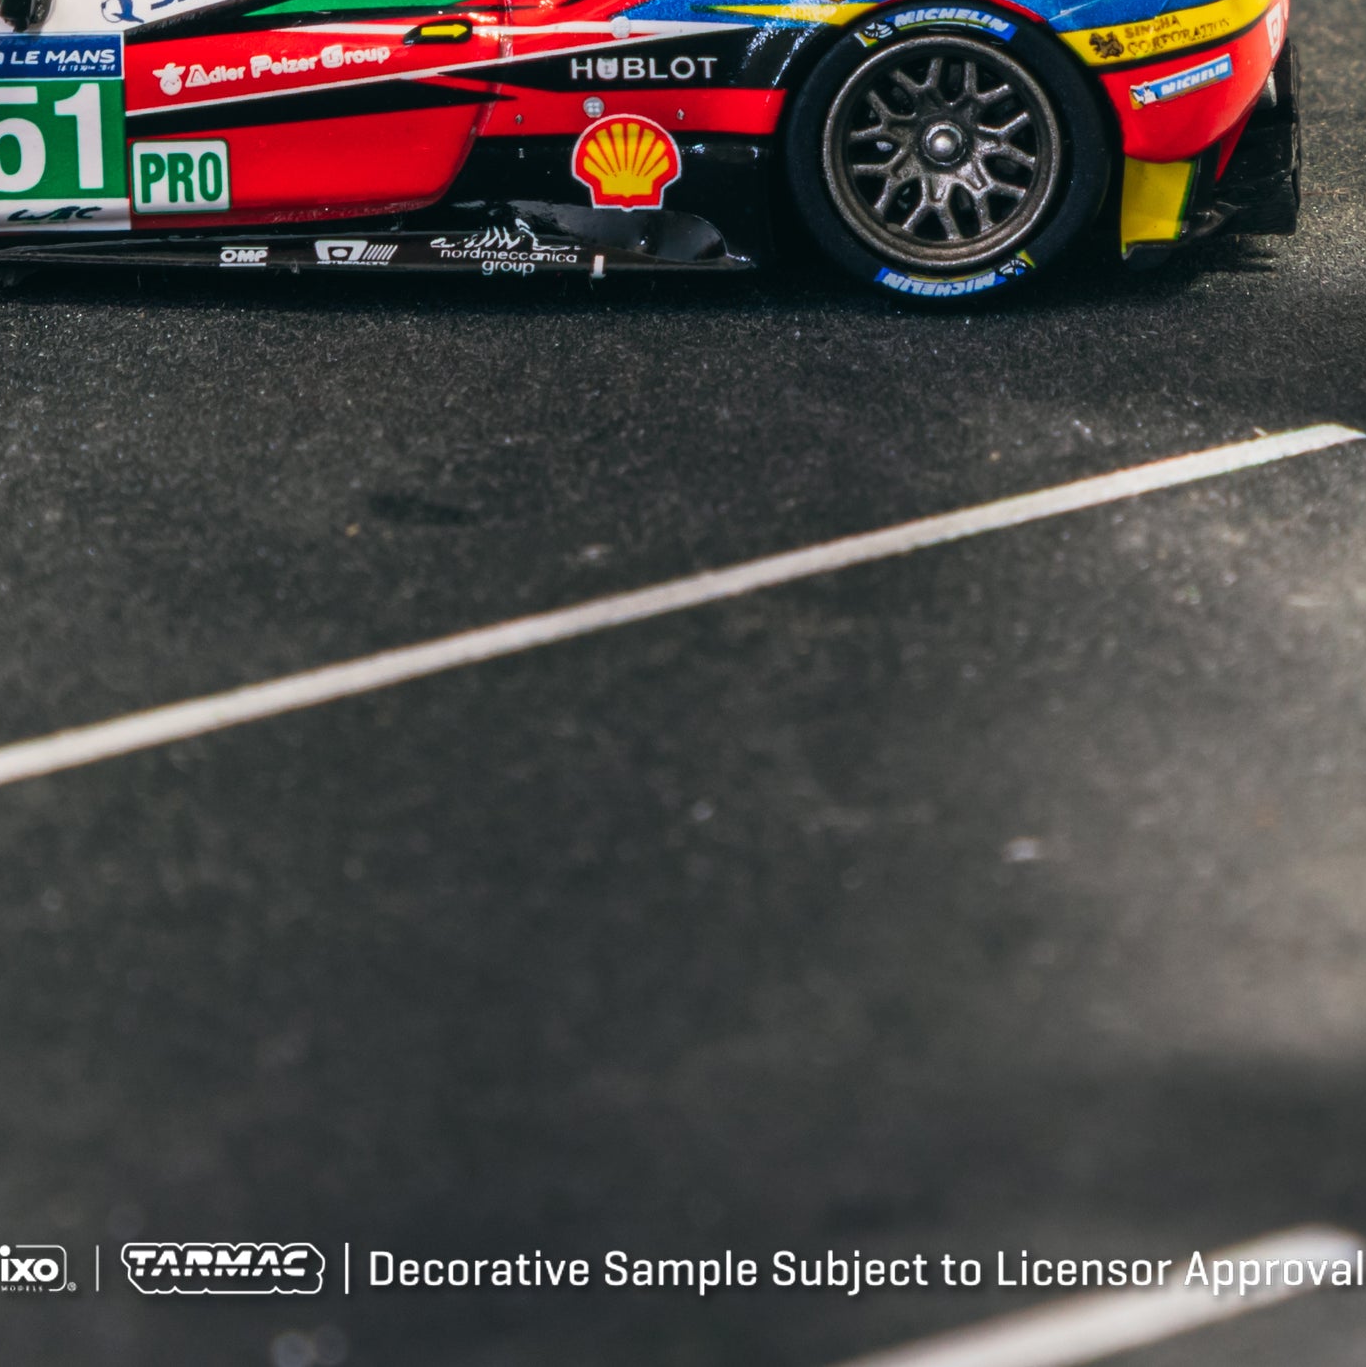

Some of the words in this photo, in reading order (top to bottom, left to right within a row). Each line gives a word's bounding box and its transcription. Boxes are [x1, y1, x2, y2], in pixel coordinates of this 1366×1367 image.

[894, 7, 1010, 33] MICHELIN
[10, 50, 41, 65] LE
[45, 49, 116, 65] MANS
[185, 63, 247, 88] Adler
[320, 44, 391, 70] Group
[569, 56, 718, 82] HUBLOT
[1160, 60, 1230, 96] MICHELIN
[139, 151, 224, 205] PRO
[219, 248, 269, 264] OMP
[439, 246, 578, 264] nordmeccanica
[481, 259, 536, 277] group
[882, 271, 997, 297] MICHELIN
